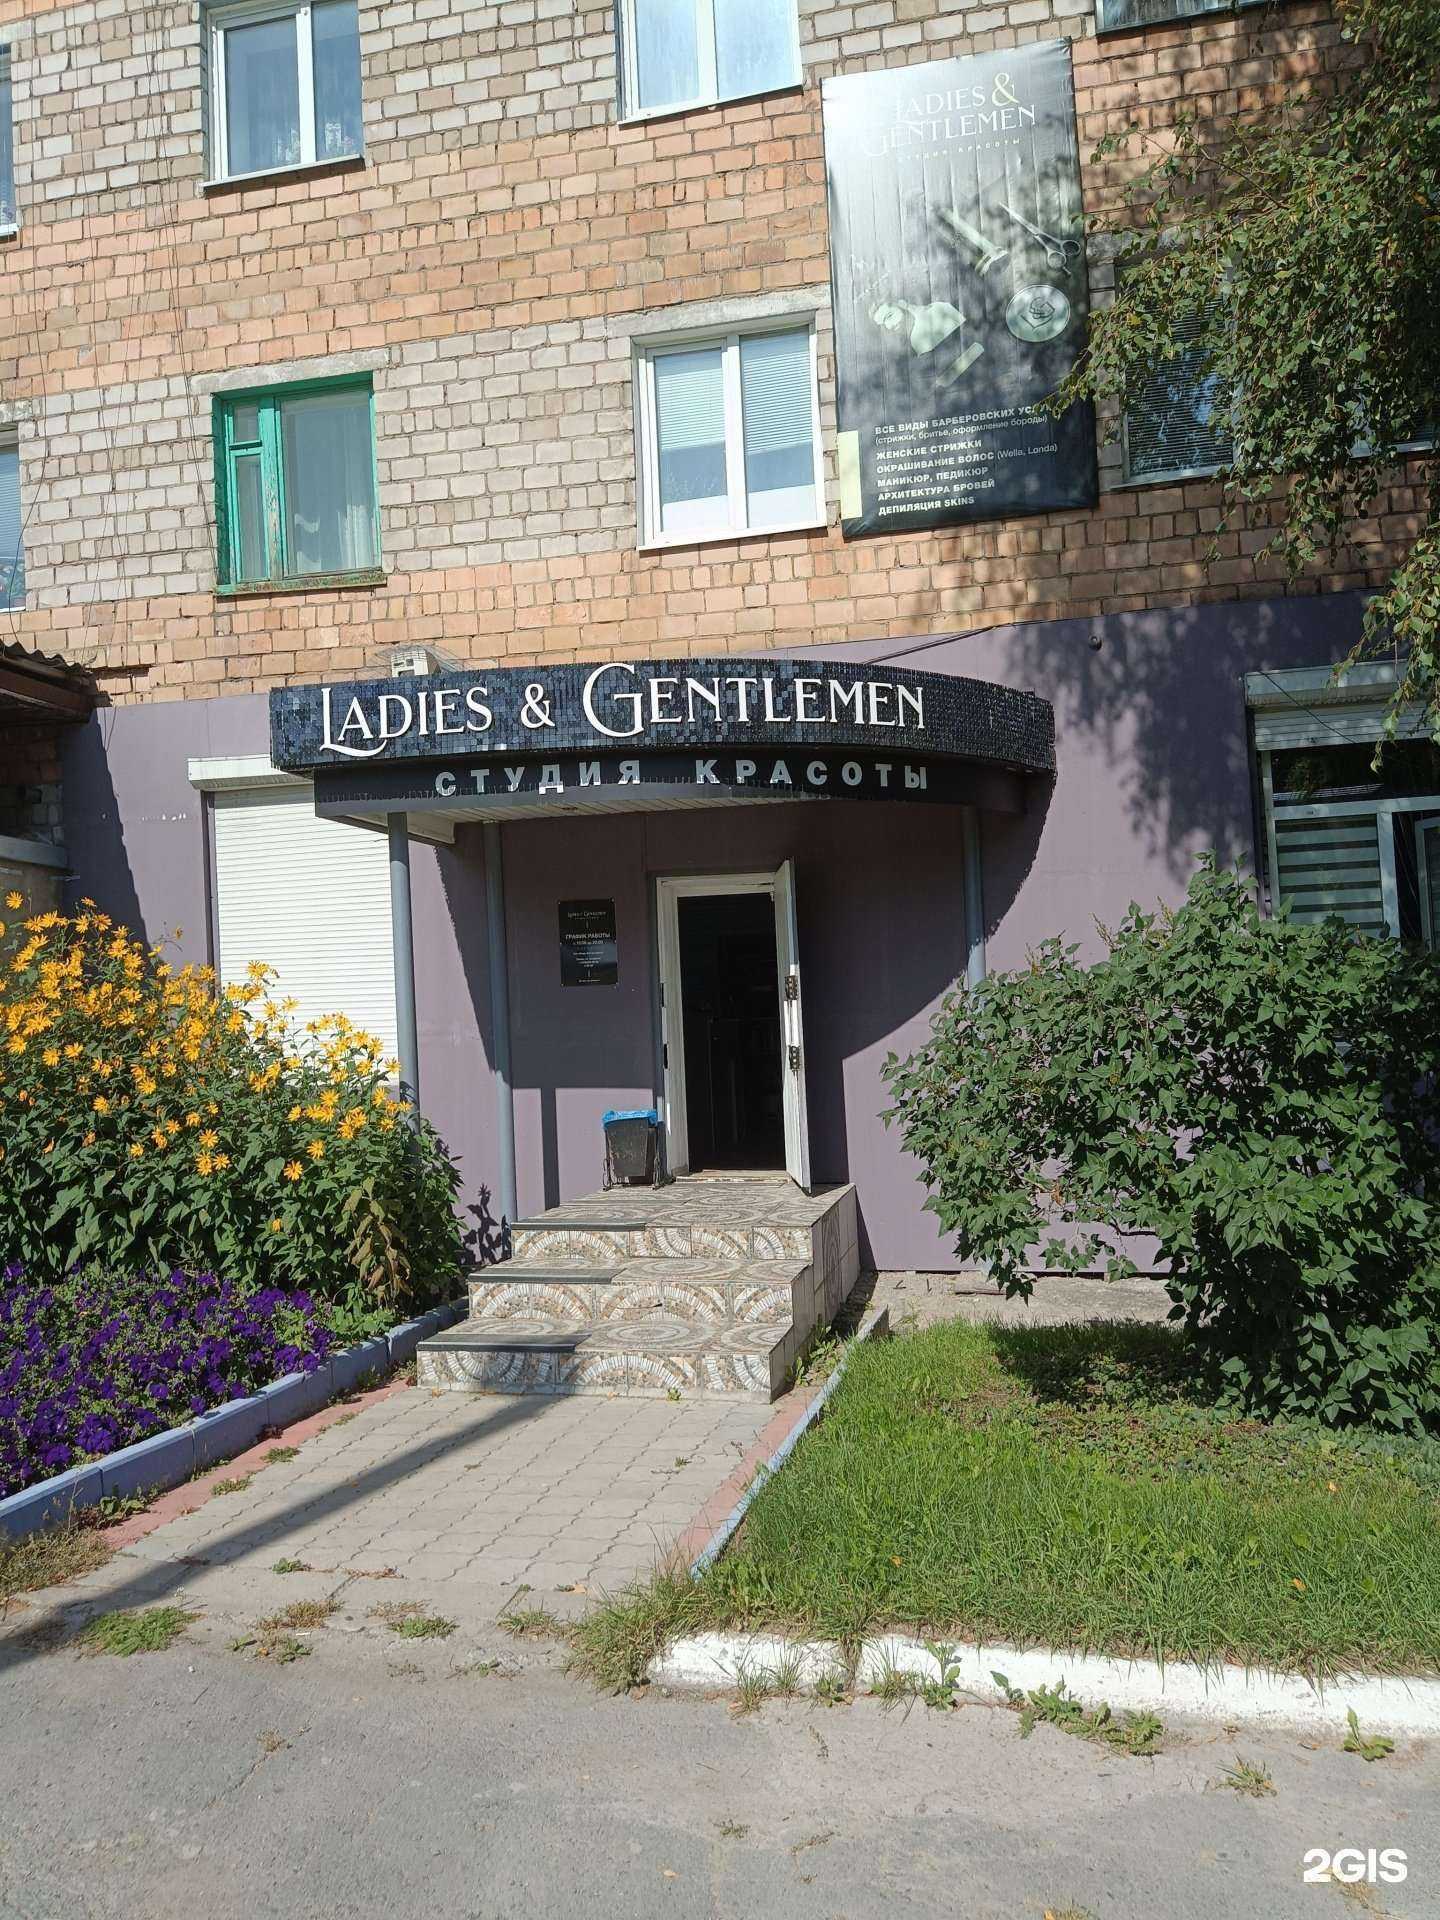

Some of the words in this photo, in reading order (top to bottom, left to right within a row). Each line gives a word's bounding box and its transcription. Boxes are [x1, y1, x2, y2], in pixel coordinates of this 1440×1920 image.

[991, 72, 1019, 107] &
[875, 426, 895, 435] ВСЕ
[898, 420, 929, 433] ВИДЫ
[931, 408, 1015, 428] БАРБЕРОВСКИХ
[952, 420, 1009, 436] оформление
[876, 446, 927, 461] ЖЕНСКИЕ
[930, 439, 982, 454] СТРИЖКИ
[876, 457, 955, 474] ОКРАШИВАНИЕ
[958, 451, 994, 464] ВОЛОС
[877, 474, 933, 487] МАНИКЮР,
[936, 467, 989, 482] ПЕДИКЮР
[878, 485, 951, 501] АРХИТЕКТУРА
[953, 478, 995, 493] БРОВЕЙ
[878, 501, 942, 516] ДЕПИЛЯЦИЯ
[944, 495, 975, 508] SKINS
[318, 686, 494, 757] LADIES
[520, 683, 556, 729] &
[582, 662, 924, 738] GENTLEMEN
[435, 760, 641, 797] СТУДИЯ
[695, 758, 928, 790] КРАСОТЫ
